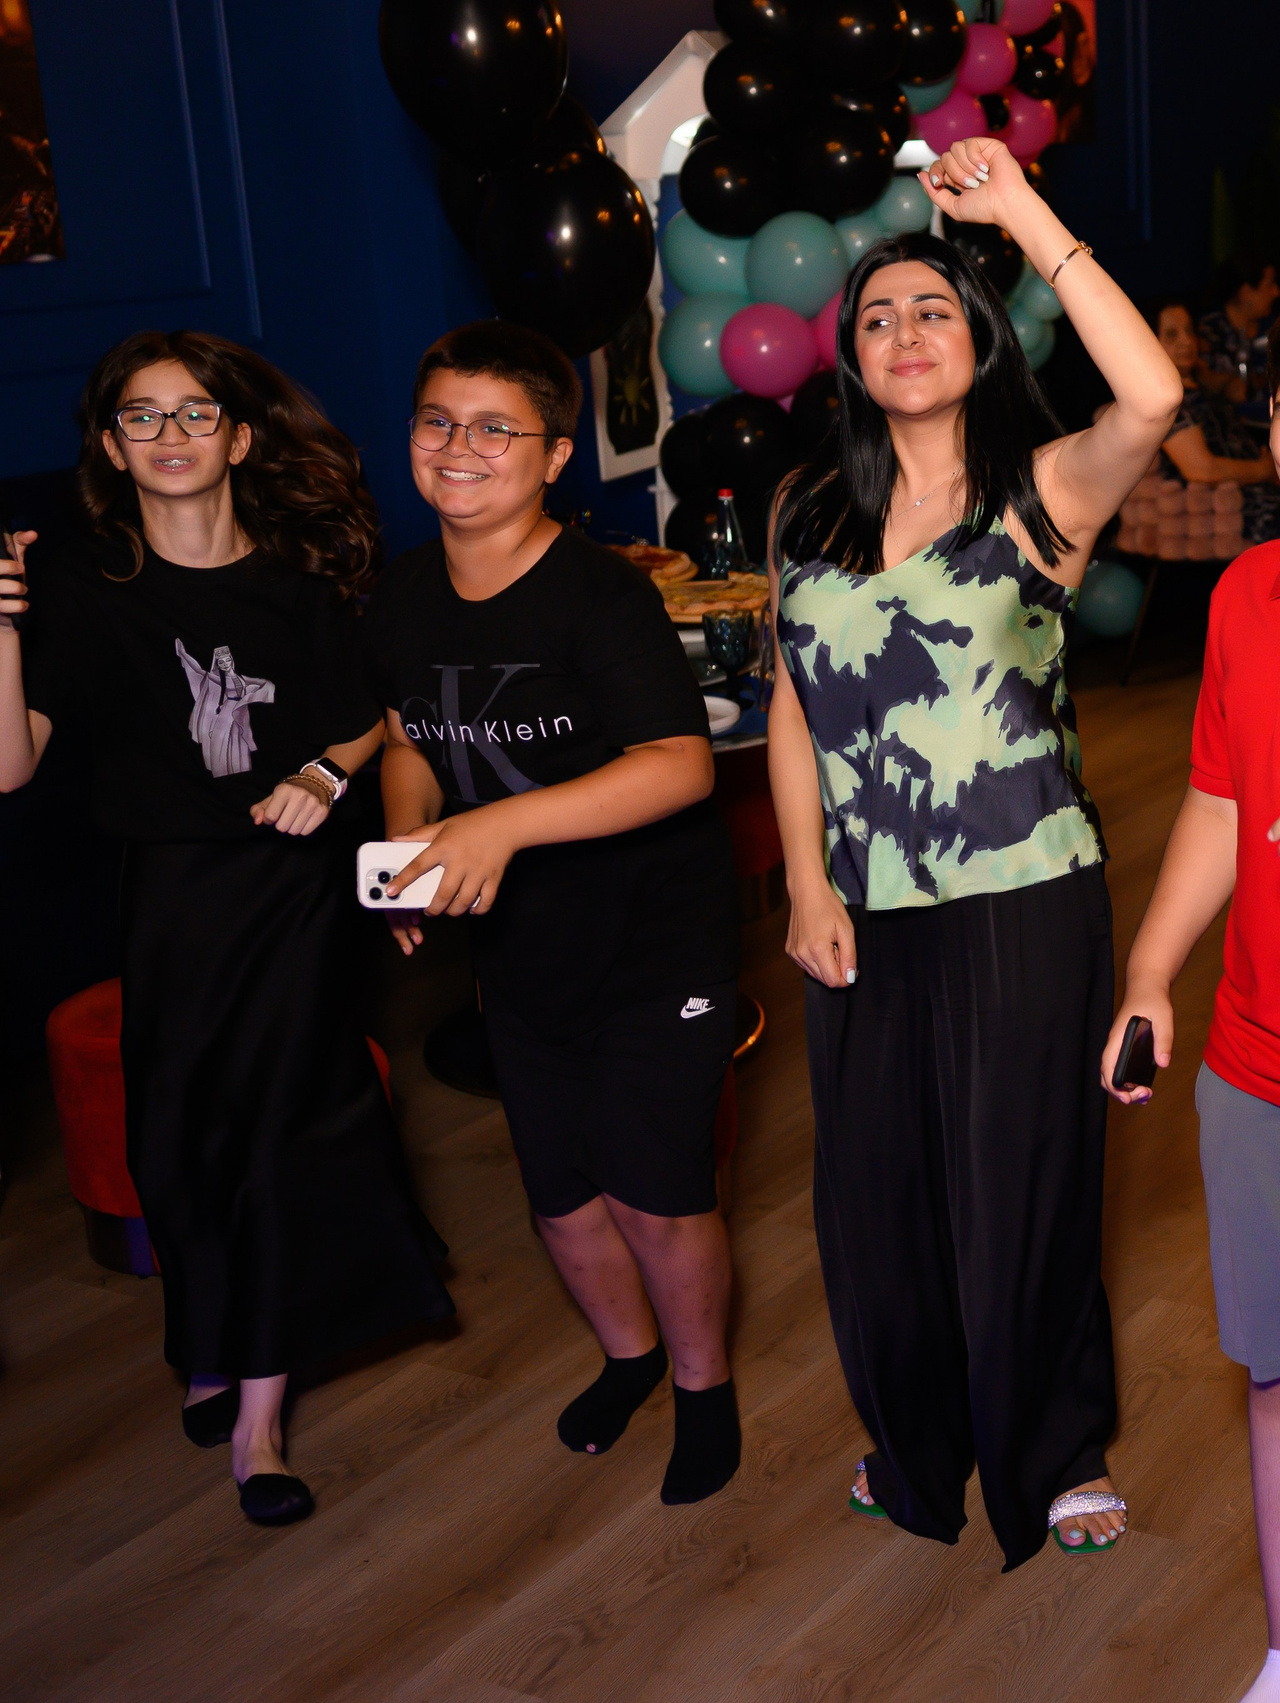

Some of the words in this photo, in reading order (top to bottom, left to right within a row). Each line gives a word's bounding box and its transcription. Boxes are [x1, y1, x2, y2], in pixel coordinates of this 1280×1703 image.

[400, 716, 475, 743] alvin
[484, 715, 573, 743] Klein
[686, 996, 710, 1010] NIKE
